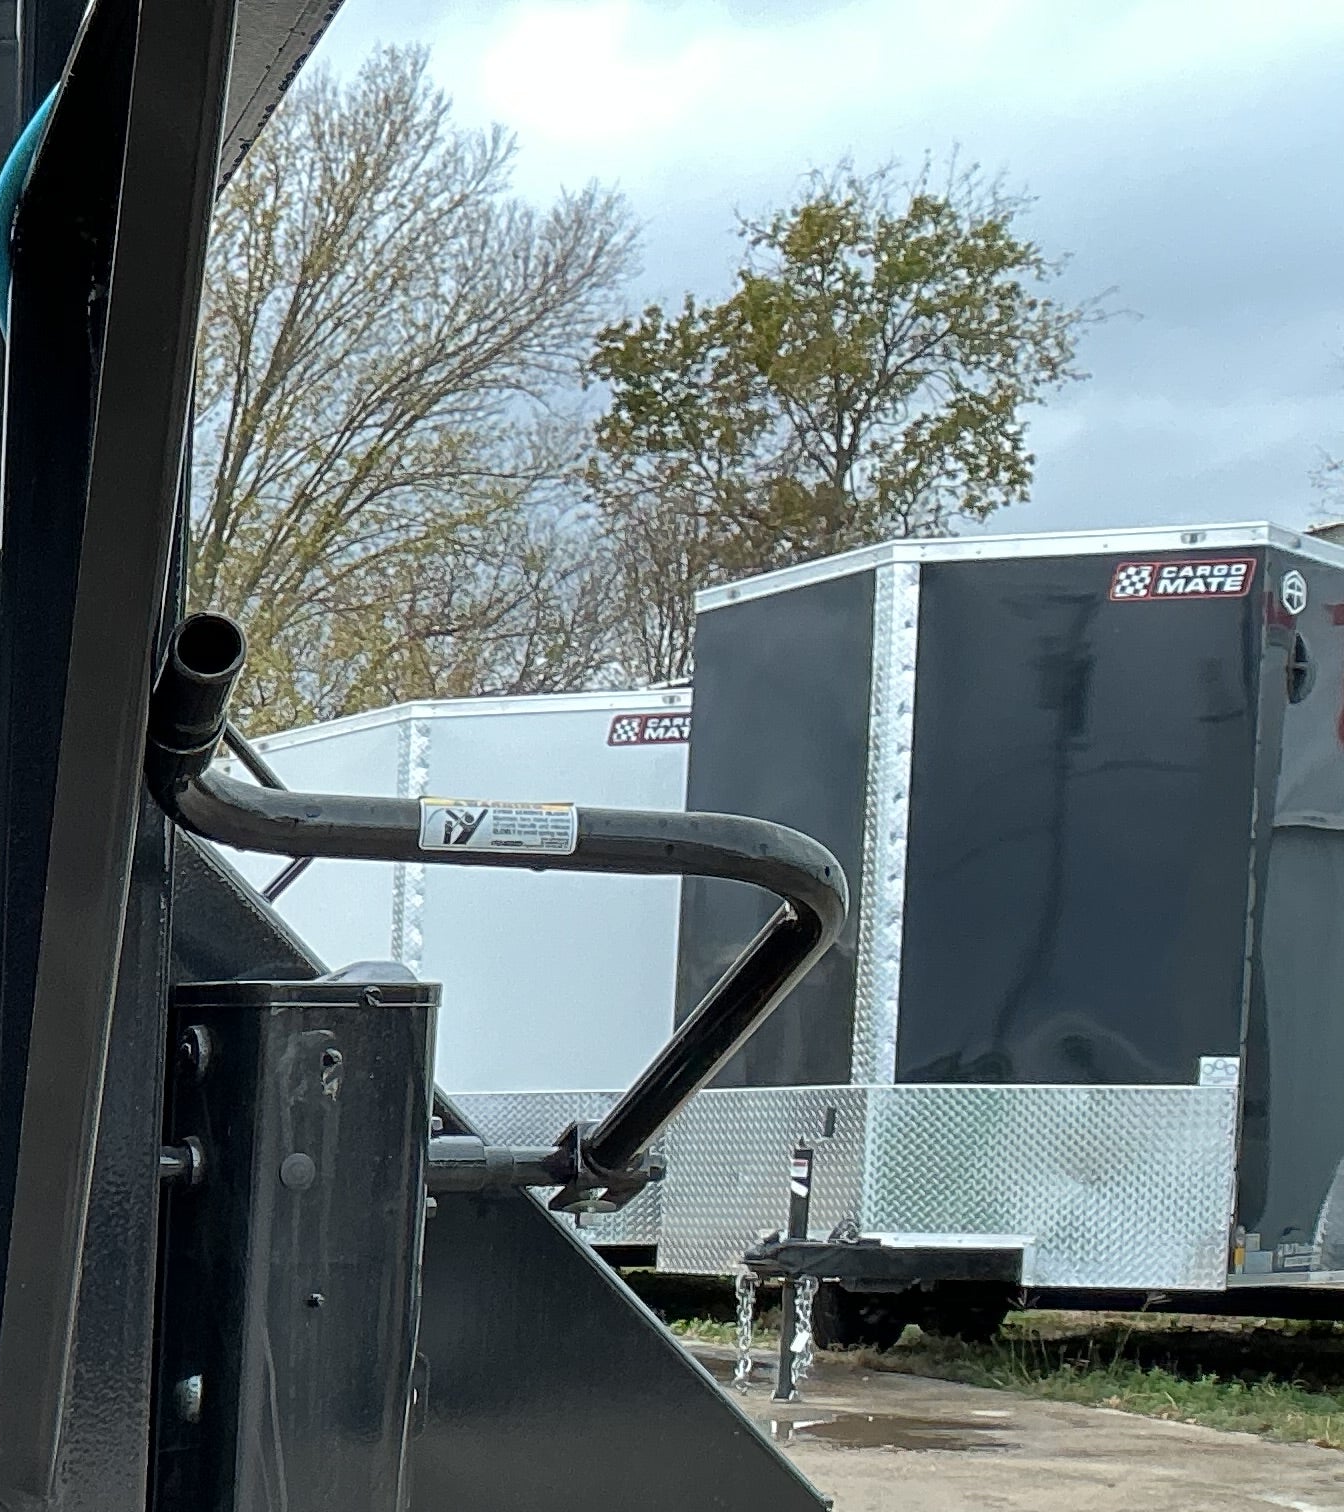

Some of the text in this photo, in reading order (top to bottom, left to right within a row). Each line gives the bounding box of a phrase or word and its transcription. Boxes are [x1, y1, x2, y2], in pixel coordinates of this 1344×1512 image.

[1161, 563, 1248, 579] CARGO
[1156, 576, 1246, 594] MATE
[647, 717, 691, 728] CAR
[644, 726, 690, 740] MAT
